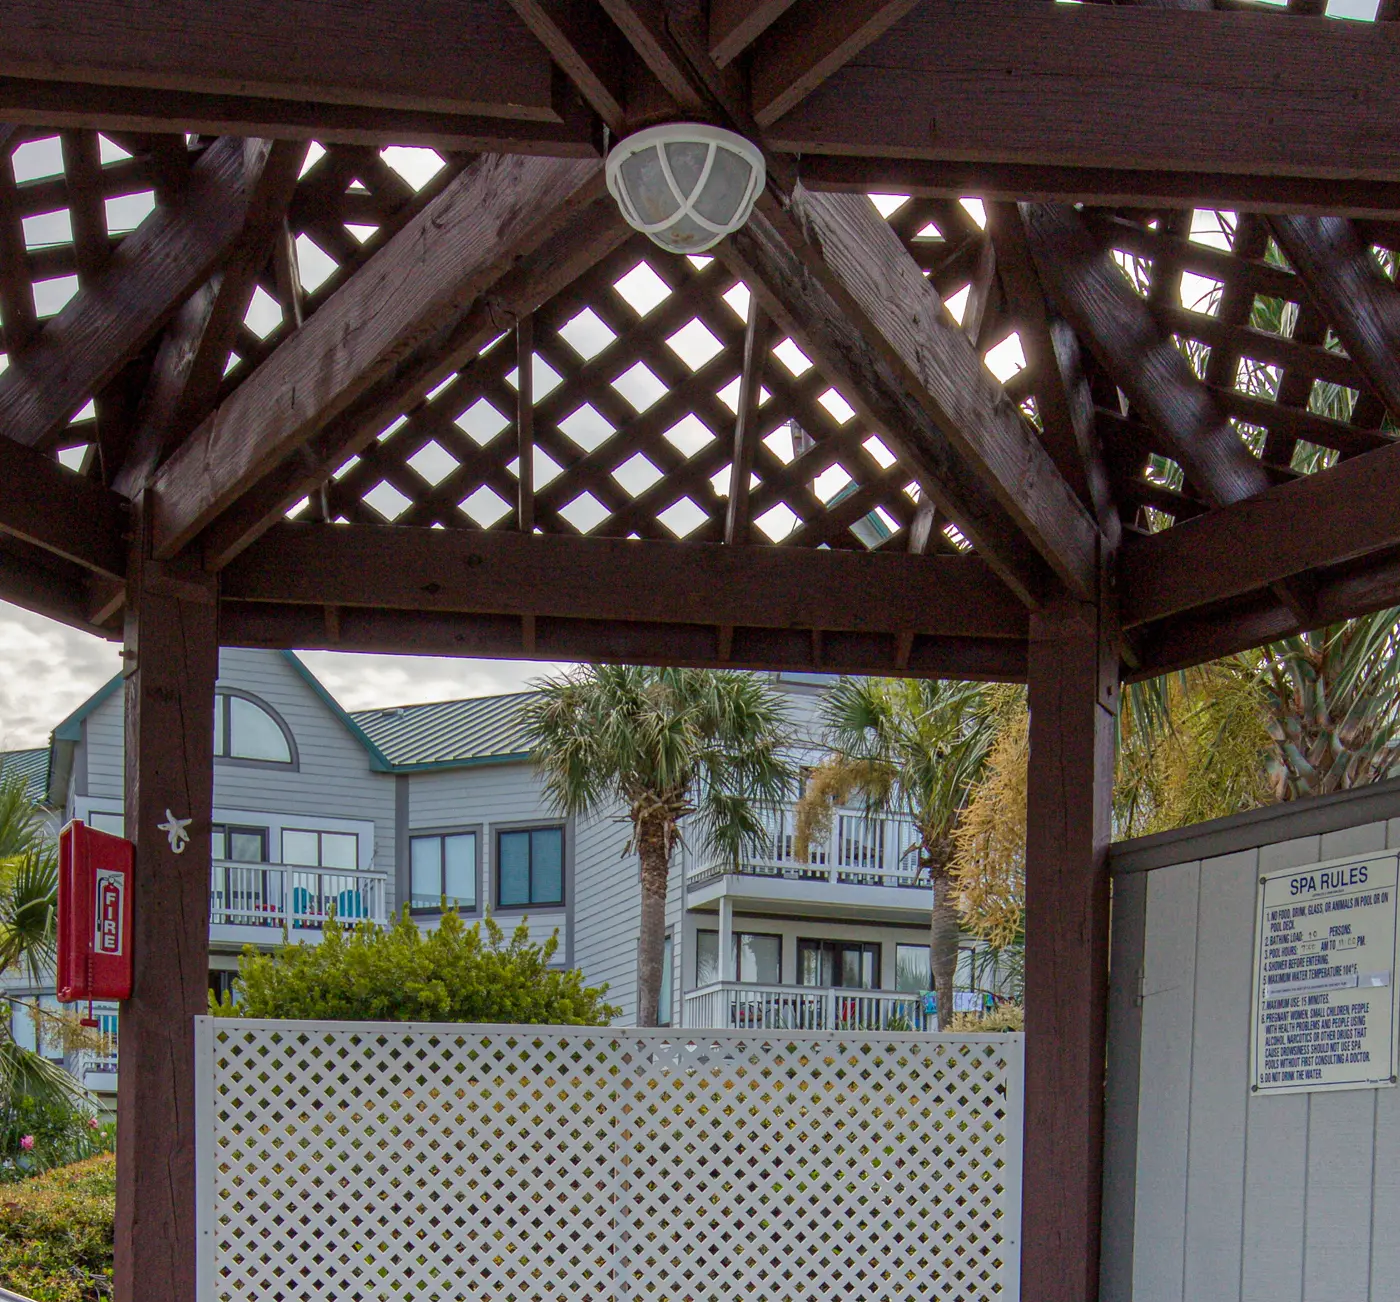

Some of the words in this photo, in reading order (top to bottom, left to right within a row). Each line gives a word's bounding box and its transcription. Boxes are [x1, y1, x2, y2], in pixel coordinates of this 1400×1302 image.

[1290, 876, 1316, 895] SPA
[1320, 866, 1368, 890] RULES
[1332, 898, 1353, 911] ANIMALS
[1360, 895, 1372, 907] POOL
[104, 892, 116, 949] FIRE
[1271, 922, 1281, 933] POOL
[1270, 933, 1289, 946] BATHING
[1270, 948, 1280, 959] POOL
[1321, 941, 1329, 951] AM
[1330, 940, 1336, 950] TO
[1269, 960, 1287, 971] SHOWER
[1289, 957, 1305, 969] BEFORE
[1268, 972, 1290, 984] MAXIMUM
[1292, 970, 1307, 981] WATER
[1309, 965, 1342, 980] TEMPERATURE
[1267, 999, 1289, 1010] MAXIMUM
[1291, 997, 1299, 1008] USE
[1302, 996, 1307, 1006] 15
[1266, 1011, 1289, 1023] PREGNANT
[1310, 1007, 1325, 1019] SMALL
[1351, 1002, 1369, 1014] PEOPLE
[1266, 1023, 1277, 1035] WITH
[1278, 1022, 1295, 1034] HEALTH
[1296, 1019, 1320, 1032] PROBLEMS
[1321, 1018, 1331, 1029] AND
[1332, 1017, 1349, 1029] PEOPLE
[1350, 1015, 1366, 1027] USING
[1287, 1032, 1312, 1044] NARCOTICS
[1313, 1031, 1320, 1042] OR
[1321, 1030, 1336, 1042] OTHER
[1337, 1028, 1353, 1040] DRUGS
[1354, 1027, 1367, 1038] THAT
[1265, 1047, 1279, 1058] CAUSE
[1280, 1044, 1309, 1057] DROWSINESS
[1310, 1042, 1329, 1054] SHOULD
[1330, 1041, 1340, 1052] NOT
[1341, 1040, 1350, 1052] USE
[1351, 1040, 1361, 1050] SPA
[1265, 1059, 1279, 1070] POOLS
[1280, 1057, 1300, 1069] WITHOUT
[1301, 1056, 1314, 1067] FIRST
[1315, 1053, 1344, 1066] CONSULTING
[1265, 1072, 1271, 1083] DO
[1272, 1071, 1281, 1082] NOT
[1281, 1071, 1295, 1081] DRINK
[1296, 1070, 1305, 1081] THE
